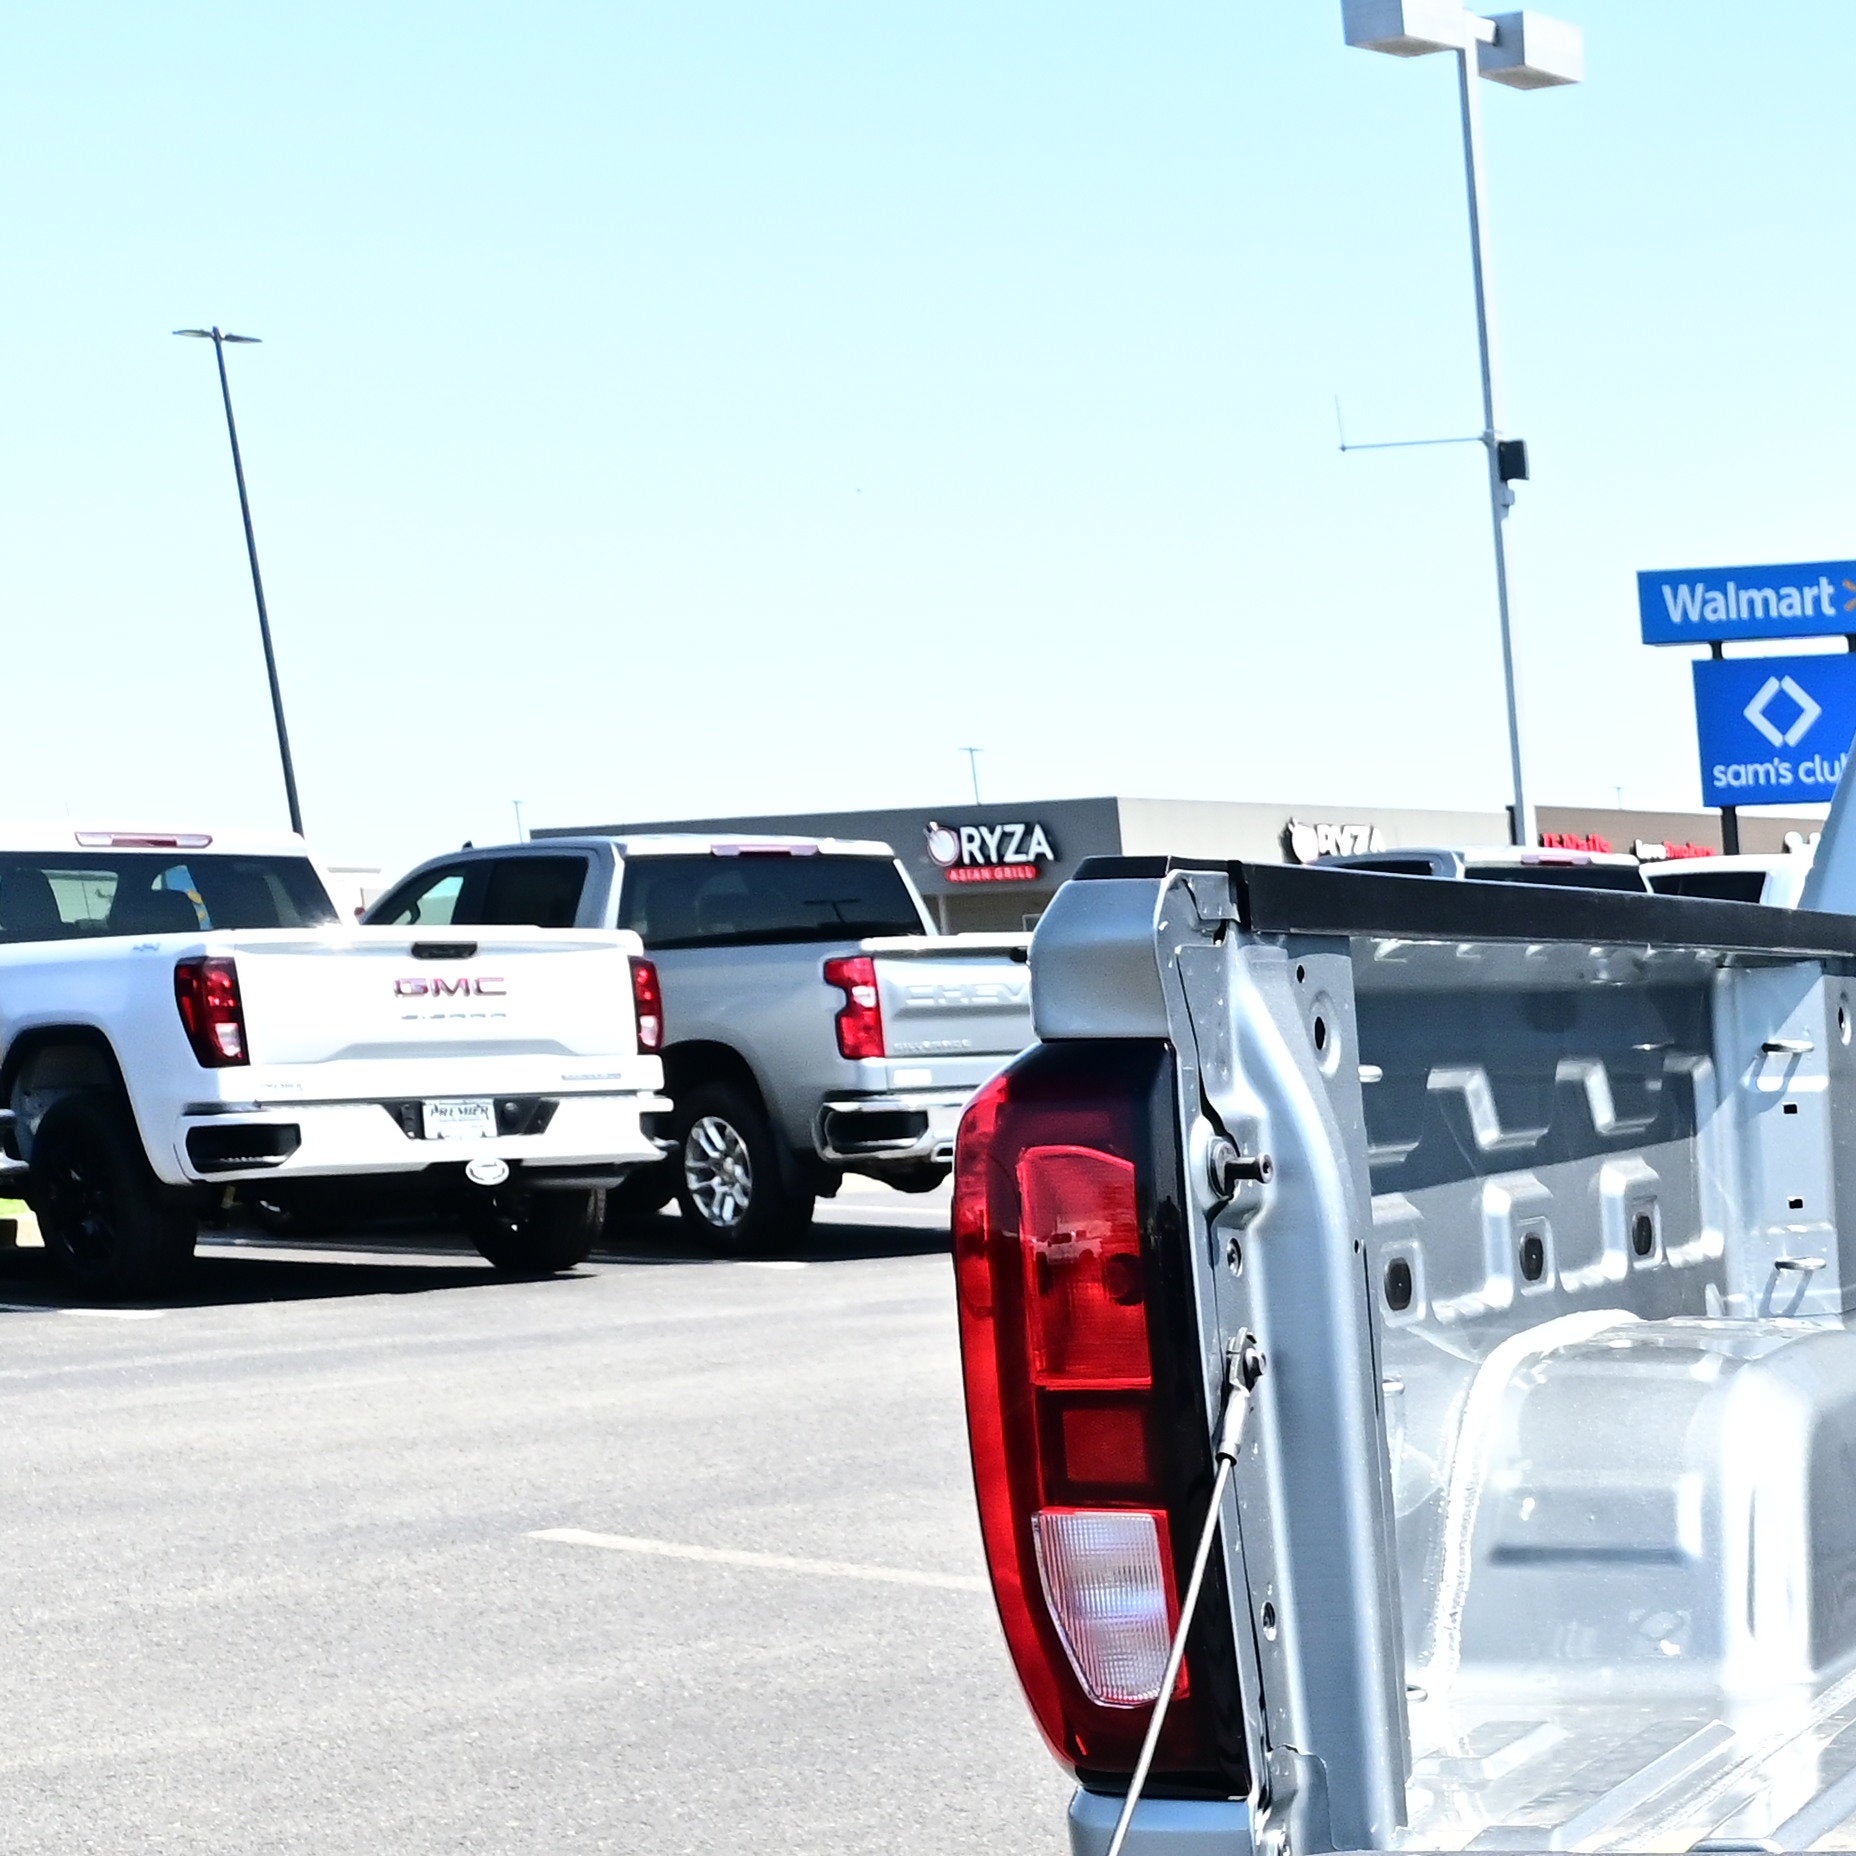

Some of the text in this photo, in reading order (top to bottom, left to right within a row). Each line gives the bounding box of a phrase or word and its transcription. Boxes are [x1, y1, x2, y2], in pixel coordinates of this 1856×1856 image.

[1662, 576, 1836, 624] Walmart
[1712, 757, 1794, 788] sam's
[950, 866, 1033, 881] ASIAN GRILL
[393, 978, 507, 997] GMC
